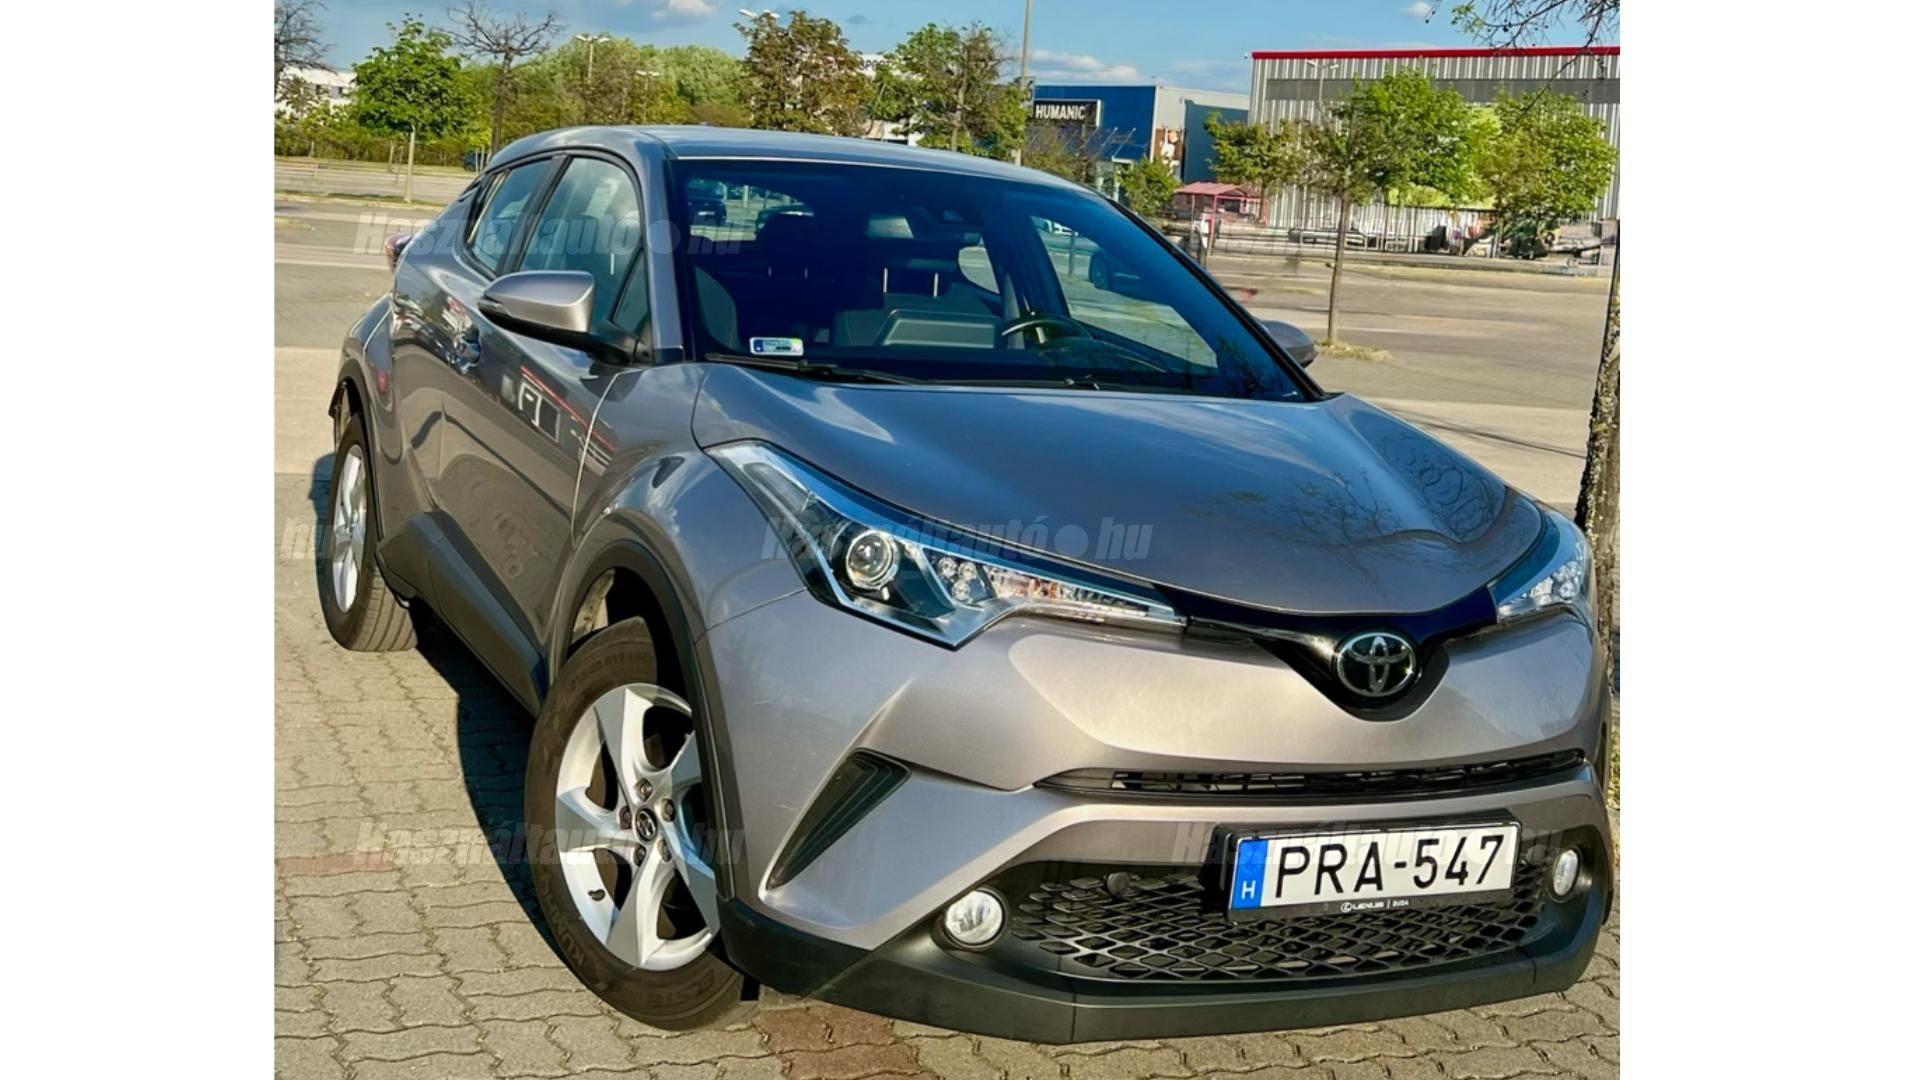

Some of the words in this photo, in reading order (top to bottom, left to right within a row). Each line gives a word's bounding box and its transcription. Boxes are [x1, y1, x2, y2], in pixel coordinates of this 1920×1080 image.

[1035, 104, 1086, 119] HUMANIC
[1275, 834, 1504, 898] PRA-547
[1241, 880, 1256, 899] H
